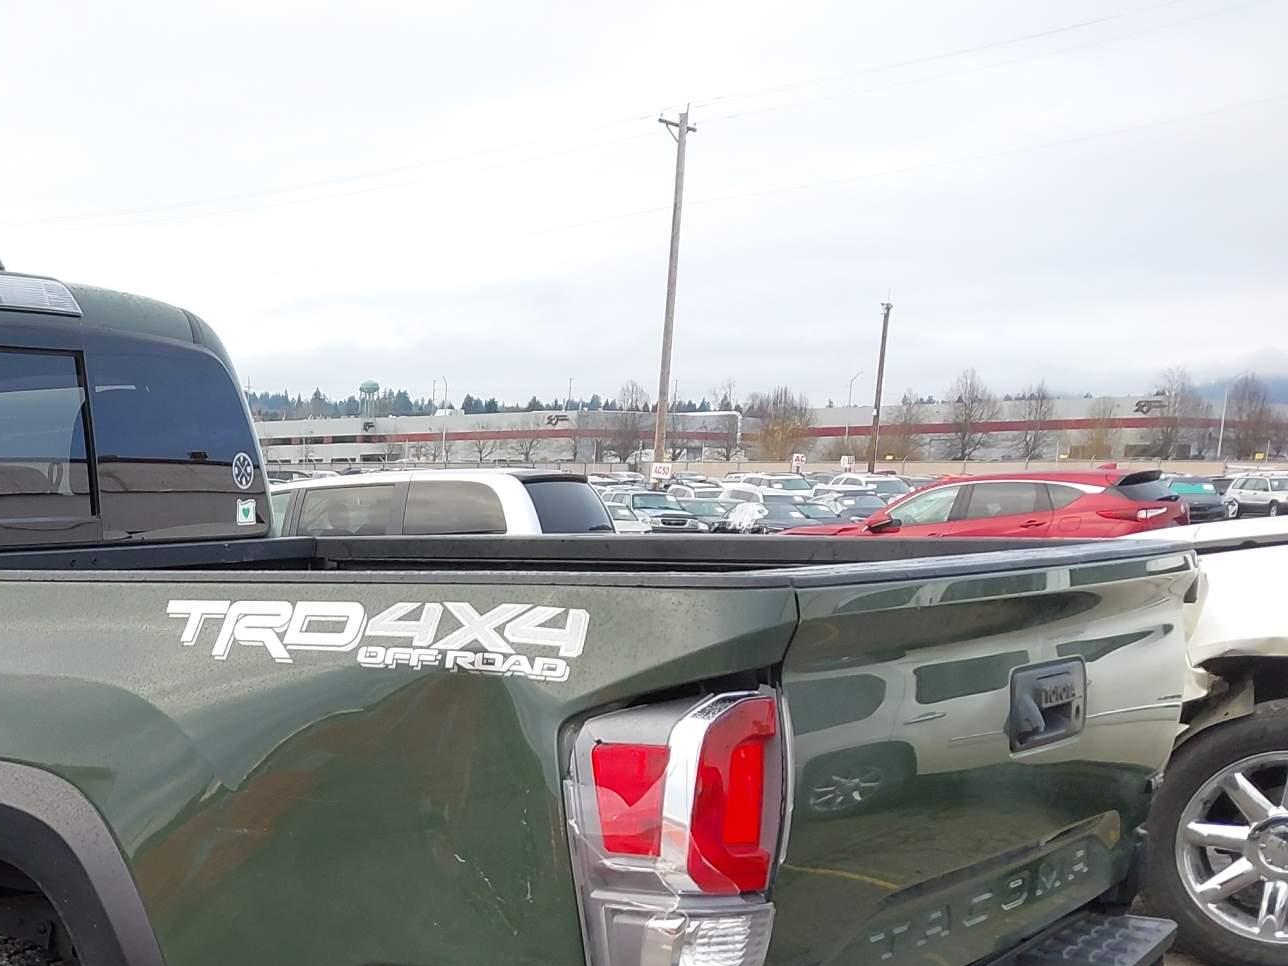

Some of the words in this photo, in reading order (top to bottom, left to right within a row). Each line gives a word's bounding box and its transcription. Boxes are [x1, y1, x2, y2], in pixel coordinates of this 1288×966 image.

[167, 600, 367, 663] TRD
[357, 647, 443, 670] OFF
[444, 651, 569, 682] ROAD
[869, 848, 1090, 960] TACOMA
